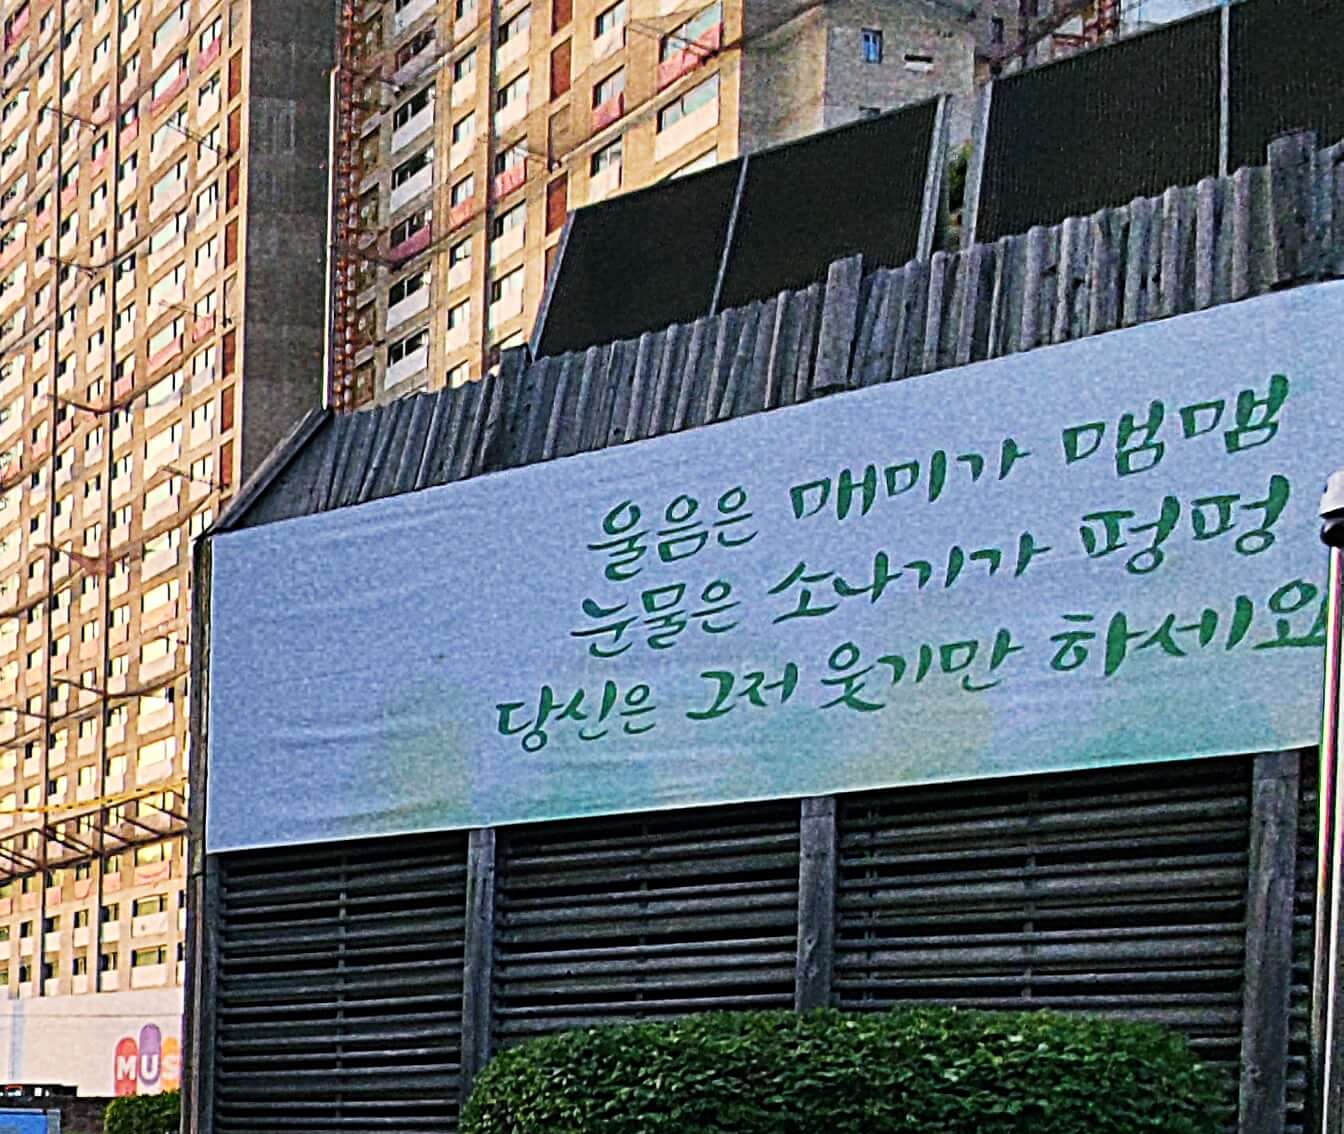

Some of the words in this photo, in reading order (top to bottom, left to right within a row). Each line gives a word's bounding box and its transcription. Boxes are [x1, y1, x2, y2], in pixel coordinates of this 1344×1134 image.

[570, 579, 742, 658] 눈물은
[767, 530, 1052, 624] 소나기가
[1079, 474, 1291, 575] 펑펑
[587, 485, 758, 581] 울음은
[789, 438, 1032, 520] 매미가
[1061, 373, 1289, 477] 맴맴
[495, 679, 657, 753] 당신은
[685, 661, 799, 720] 그저
[819, 627, 1025, 713] 웃기만
[1049, 578, 1328, 677] 하세요
